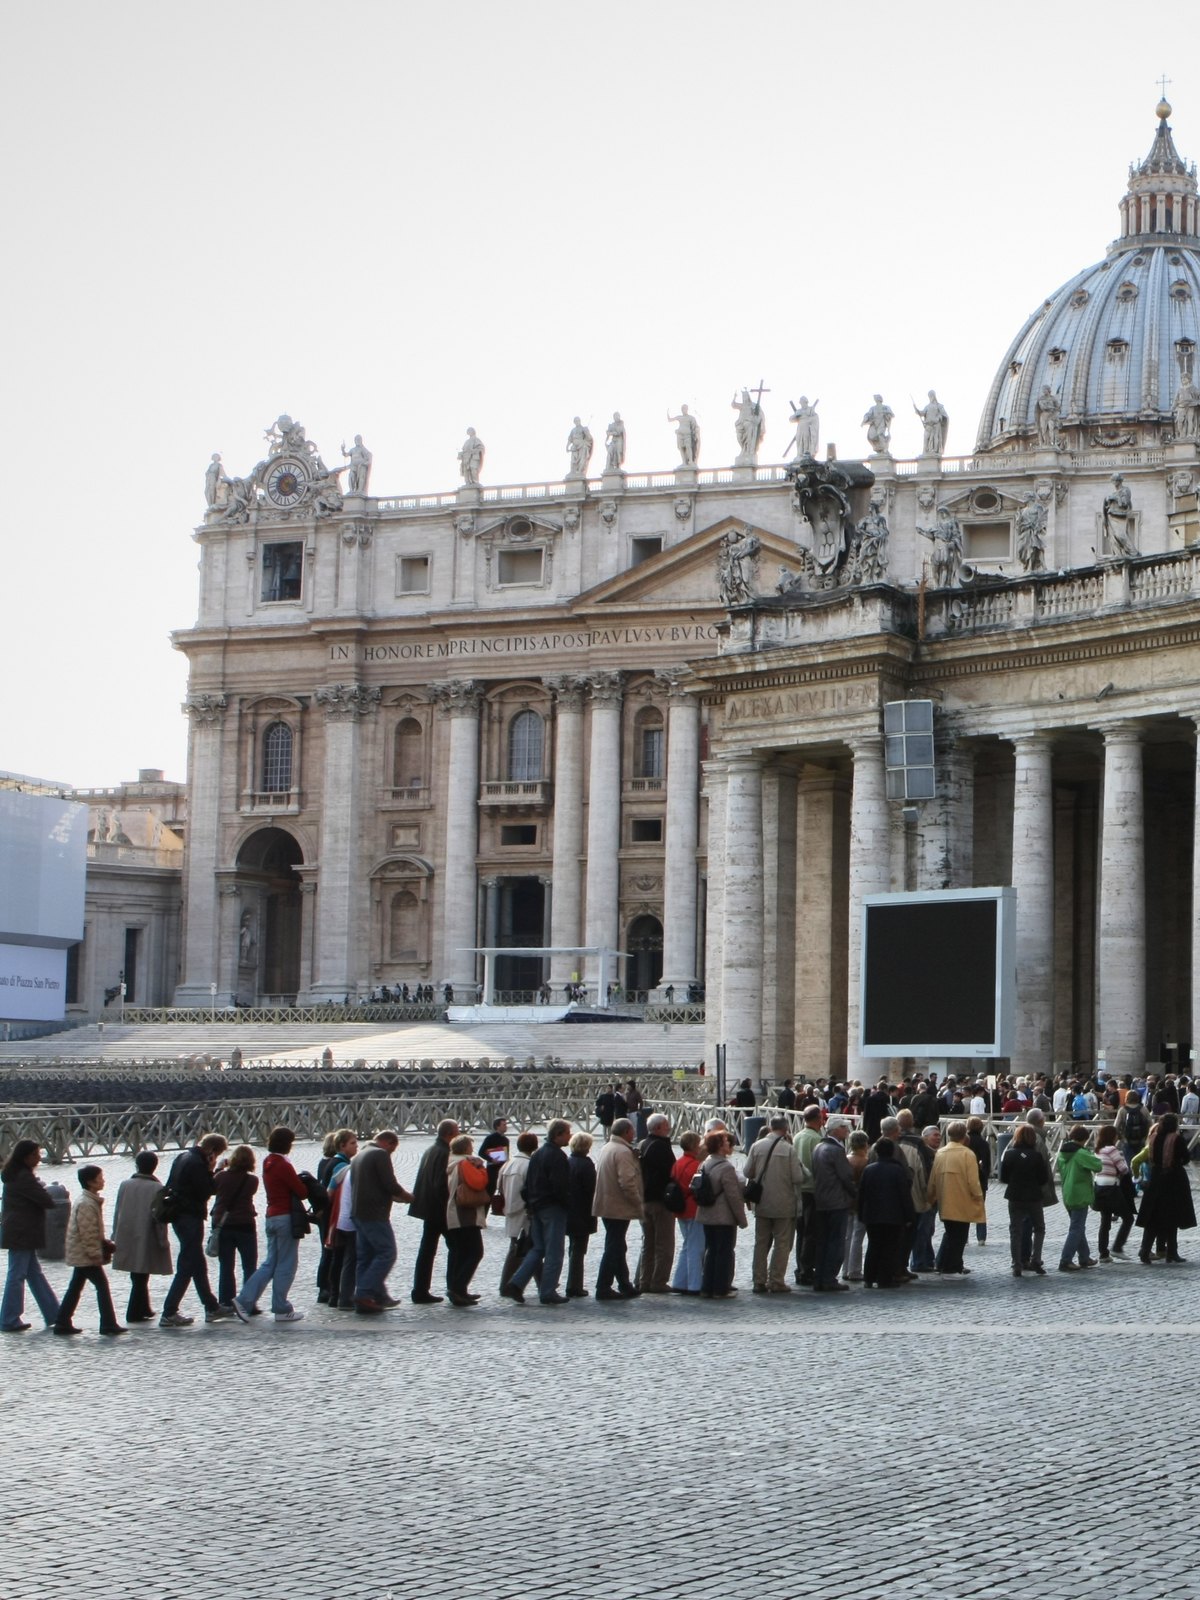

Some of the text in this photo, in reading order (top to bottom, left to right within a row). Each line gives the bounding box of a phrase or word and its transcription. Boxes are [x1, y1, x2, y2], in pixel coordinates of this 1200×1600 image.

[330, 645, 349, 660] IN
[364, 643, 449, 660] HONOREM
[449, 636, 537, 654] PRINCIPIS
[592, 628, 652, 644] PAVLVS
[655, 628, 666, 641] V
[727, 693, 799, 721] ALEXAN
[809, 688, 836, 709] VII
